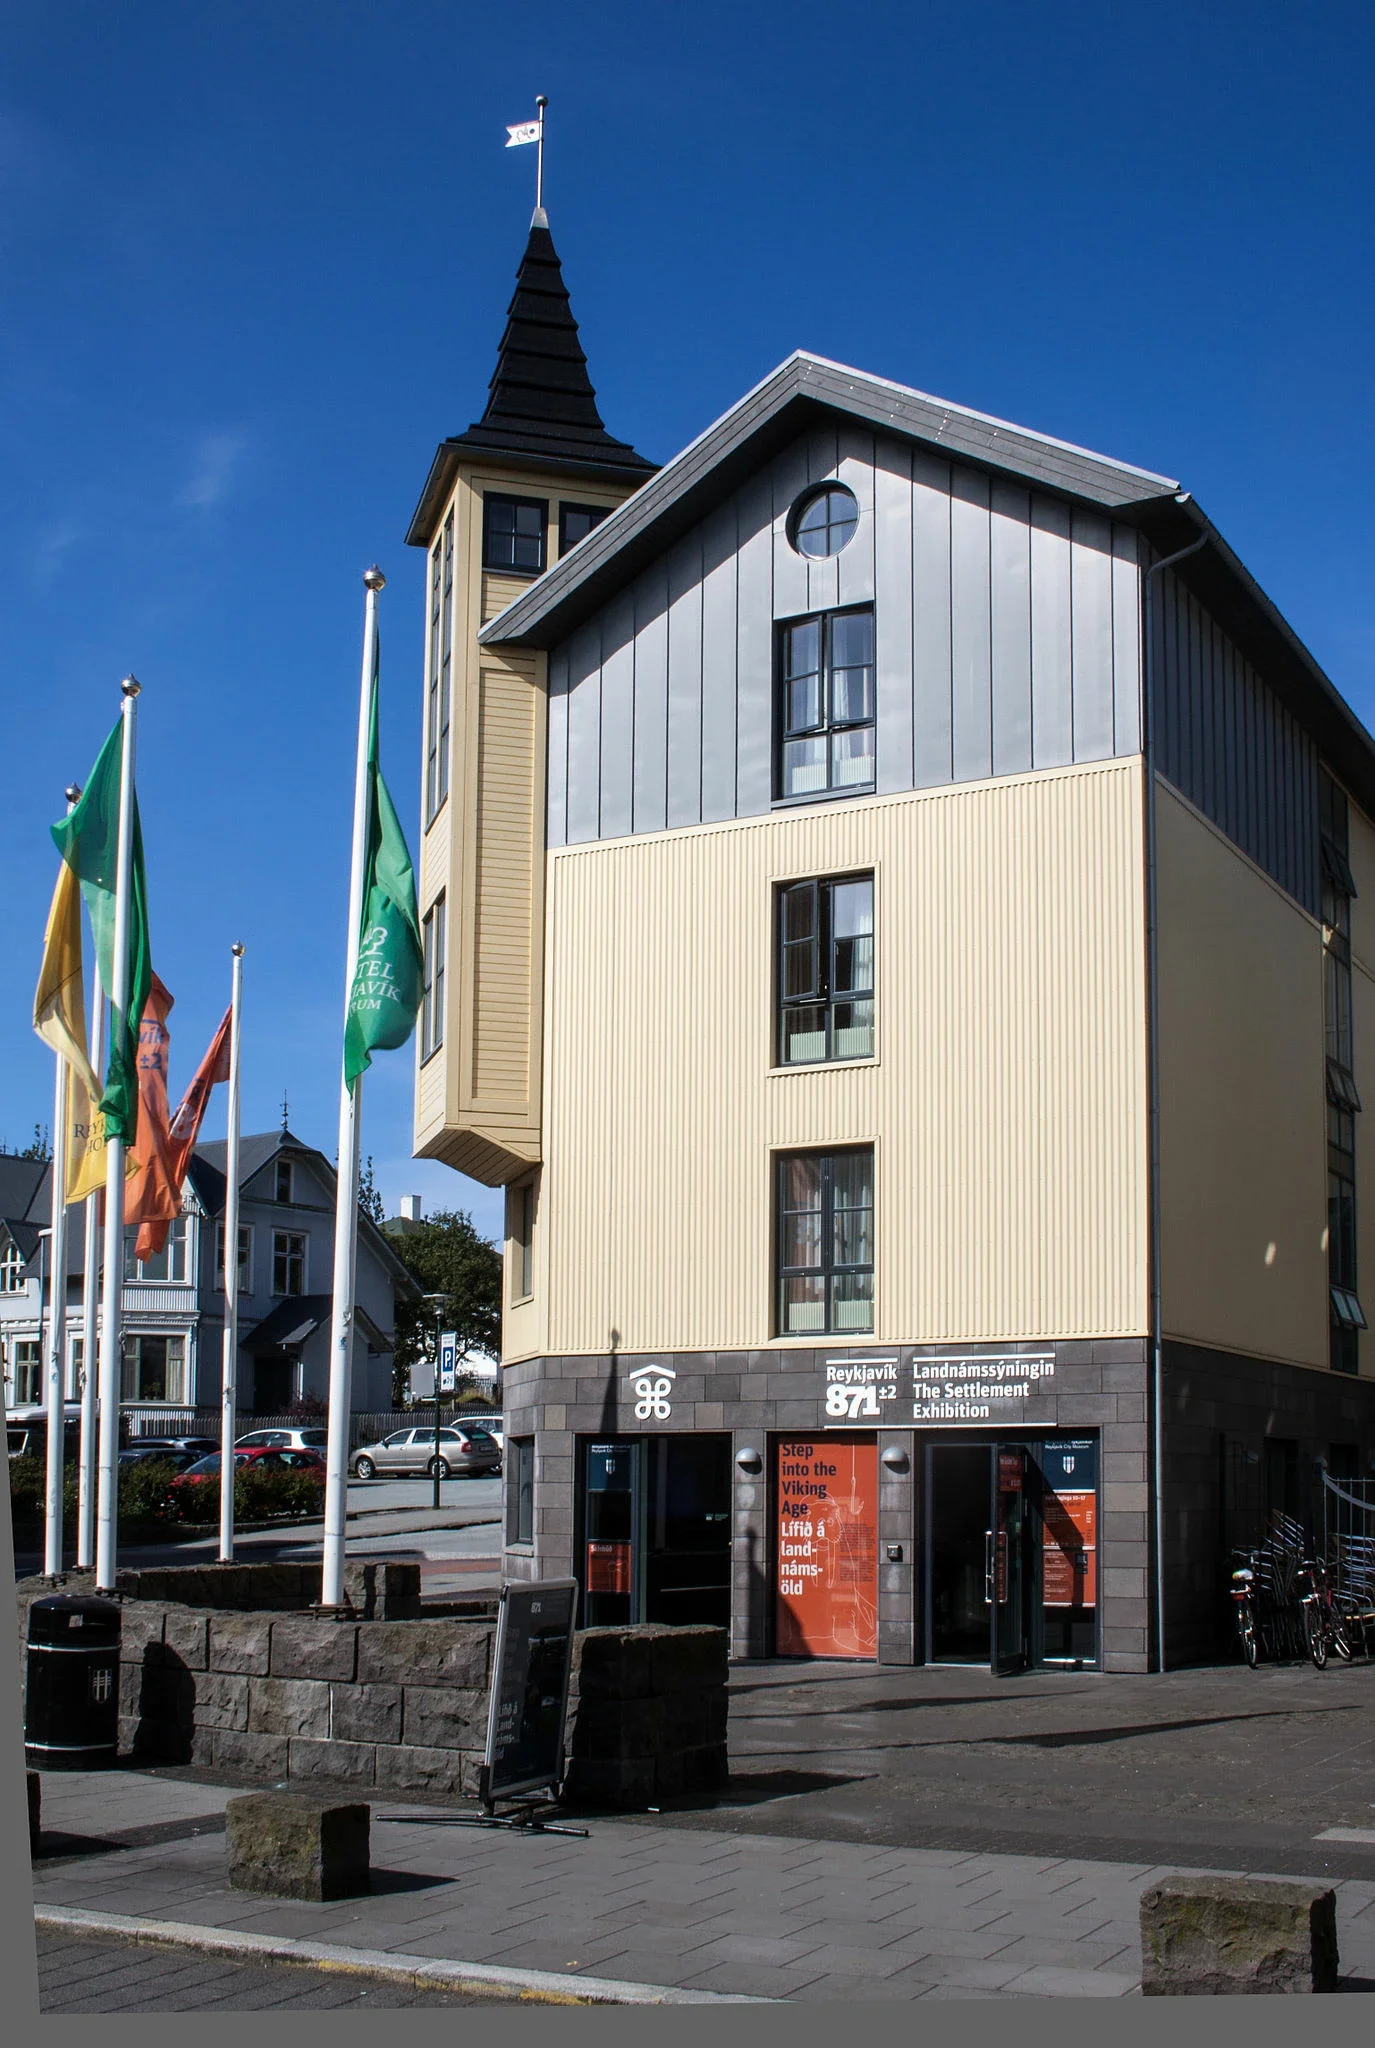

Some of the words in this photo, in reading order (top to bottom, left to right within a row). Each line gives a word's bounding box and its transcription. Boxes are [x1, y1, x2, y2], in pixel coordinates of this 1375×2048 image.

[356, 960, 395, 980] TEL
[826, 1363, 898, 1384] Reykjavík
[913, 1359, 1055, 1380] Landnámssýningin
[913, 1383, 940, 1399] The
[944, 1381, 1030, 1398] Settlement
[913, 1403, 990, 1419] Exhibition
[782, 1443, 814, 1460] Step
[782, 1462, 810, 1477] into
[814, 1462, 837, 1477] the
[782, 1481, 828, 1499] Viking
[781, 1500, 809, 1518] Age
[781, 1520, 813, 1538] Lífið
[816, 1520, 825, 1538] á
[781, 1540, 817, 1557] land-
[781, 1559, 823, 1576] náms-
[780, 1579, 803, 1596] öld
